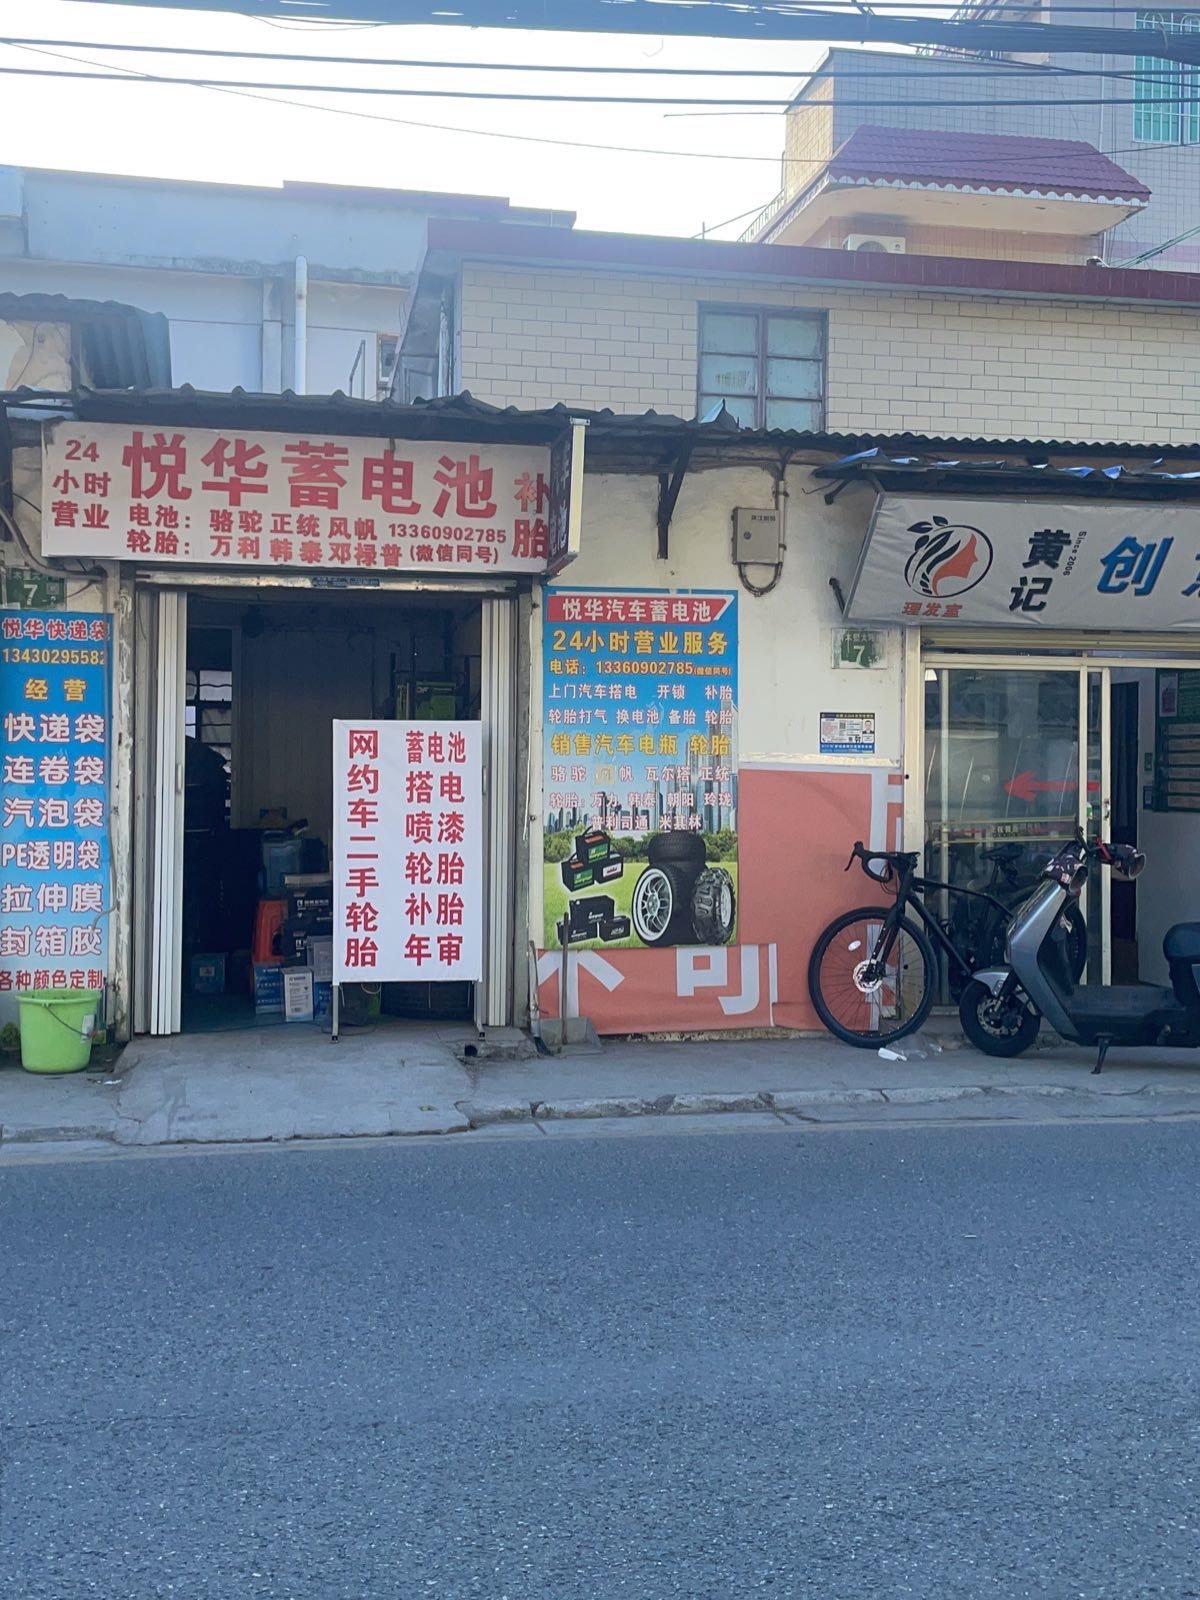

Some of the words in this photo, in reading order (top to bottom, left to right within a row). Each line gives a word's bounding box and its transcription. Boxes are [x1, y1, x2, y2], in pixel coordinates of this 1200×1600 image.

[65, 440, 99, 462] 24
[52, 469, 111, 497] 小时
[122, 431, 497, 518] 悦华蓄电池
[52, 500, 109, 529] 营业
[511, 472, 549, 560] 补胎
[389, 523, 506, 543] 13360902785
[1009, 529, 1072, 612] 黄记
[24, 584, 38, 605] 7
[562, 598, 713, 622] 悦华汽车蓄电池
[3, 617, 110, 641] 悦华快递袋
[552, 630, 728, 655] 24小时营业服务
[549, 684, 637, 700] 上门汽车搭电
[657, 684, 685, 700] 开锁
[705, 685, 732, 700] 补胎
[4, 713, 105, 743] 快递袋
[549, 709, 608, 725] 轮胎打气
[616, 709, 660, 725] 换电池
[669, 709, 696, 725] 备胎
[705, 710, 732, 725] 轮胎
[405, 731, 466, 764] 蓄电池
[552, 735, 678, 756] 销售汽车电瓶
[690, 735, 730, 756] 轮胎
[3, 755, 104, 785] 连卷袋
[646, 766, 690, 782] 瓦尔塔
[699, 766, 731, 782] 正统
[405, 771, 465, 804] 搭电
[591, 792, 618, 807] 万力
[628, 792, 656, 808] 韩泰
[667, 793, 694, 808] 朝阳
[704, 793, 732, 808] 玲珑
[3, 798, 104, 828] 汽泡袋
[405, 811, 465, 844] 喷漆
[591, 815, 649, 830] 普利司通
[659, 815, 702, 830] 米其林
[1, 841, 100, 870] PE透明袋
[345, 730, 379, 968] 网约车二手轮胎
[405, 851, 464, 885] 轮胎
[1, 883, 103, 913] 拉伸膜
[405, 892, 464, 926] 补胎
[0, 925, 102, 957] 封箱胶
[404, 933, 463, 966] 年审
[0, 970, 104, 991] 各种颜色定制
